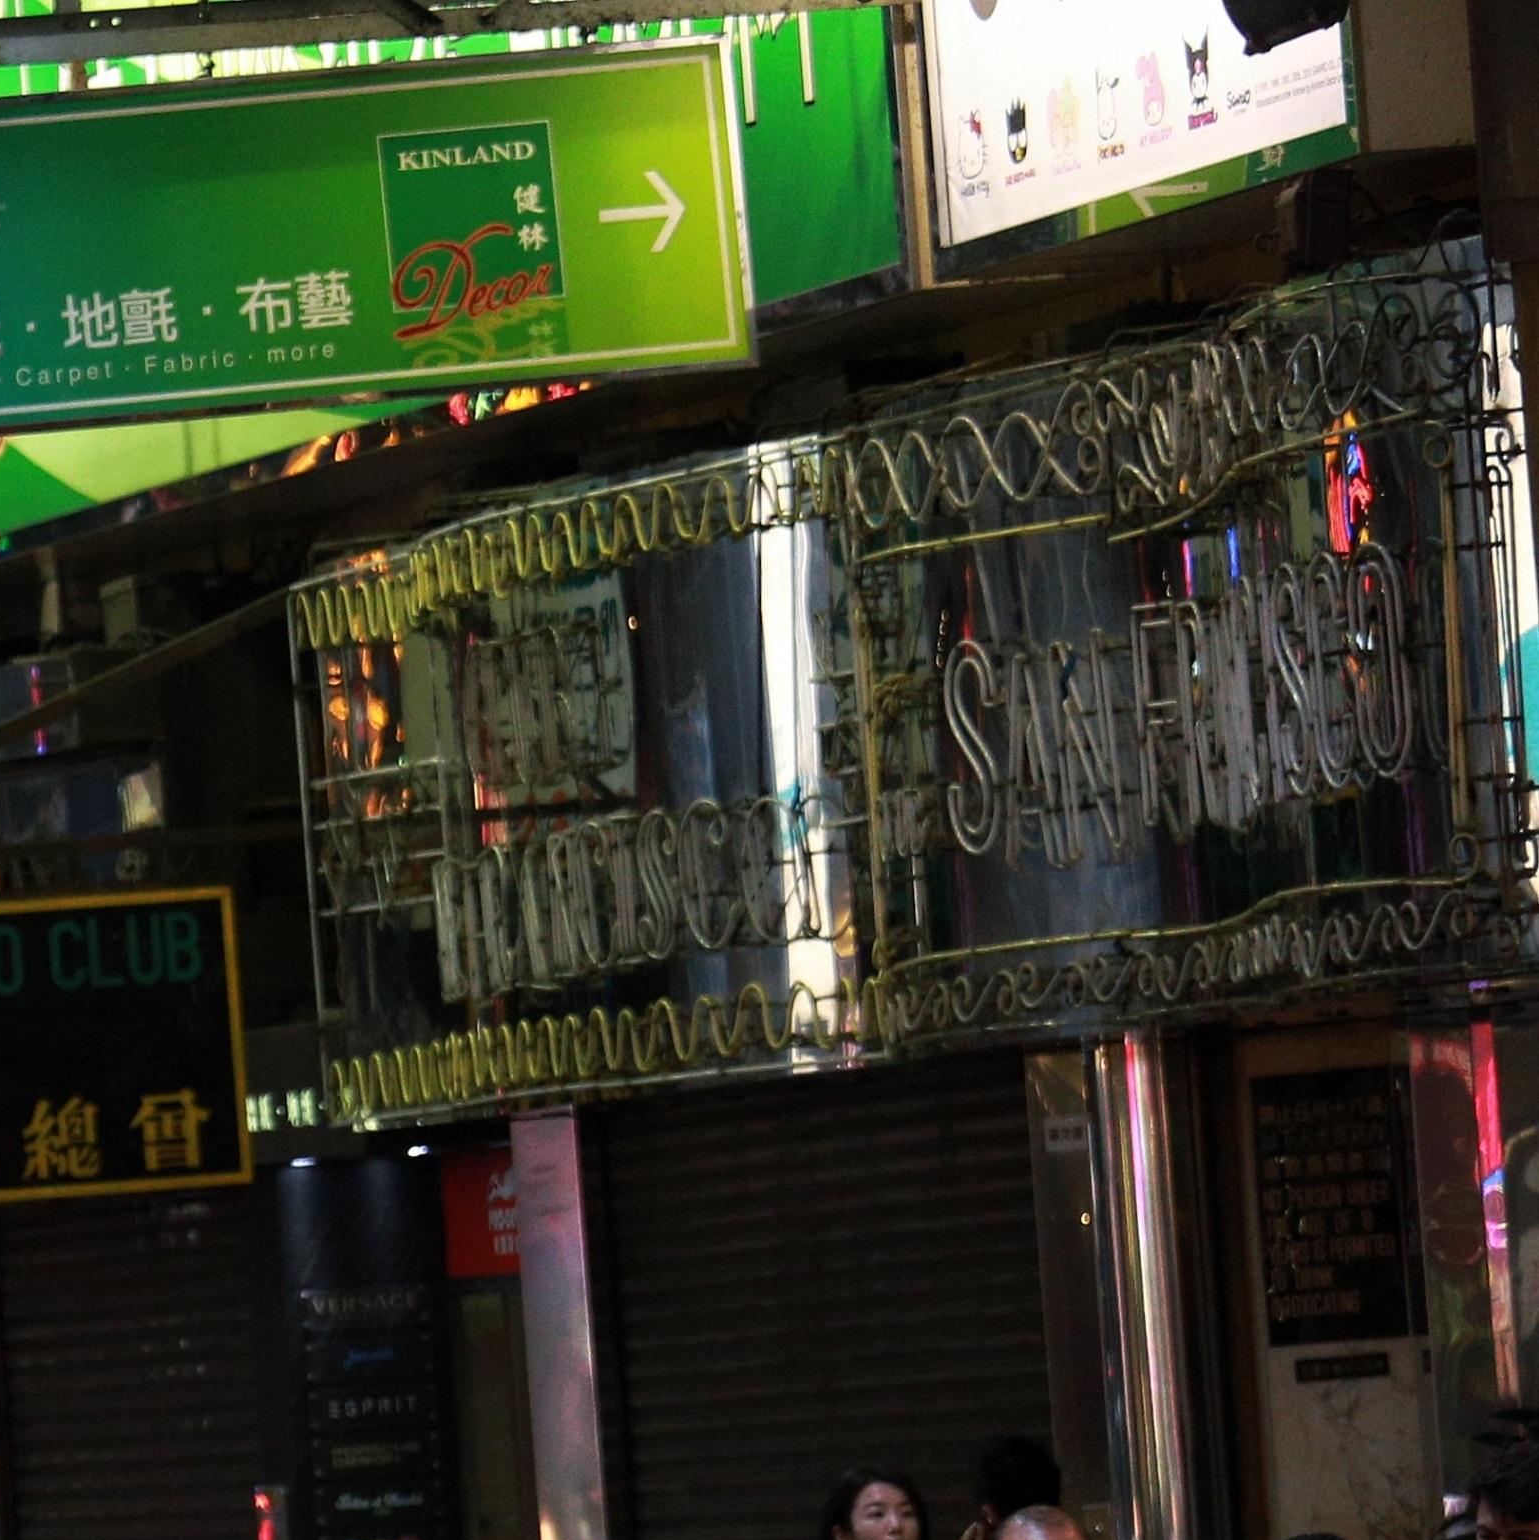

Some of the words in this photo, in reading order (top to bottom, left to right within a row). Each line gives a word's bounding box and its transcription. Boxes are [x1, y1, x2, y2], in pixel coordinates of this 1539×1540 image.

[398, 141, 536, 171] KINLAND
[513, 183, 549, 251] 健林
[60, 288, 178, 349] 地氈
[236, 271, 353, 334] 布藝
[393, 223, 554, 341] Decor
[15, 361, 113, 388] Carpet
[144, 349, 236, 373] Fabric
[267, 342, 336, 362] more
[48, 911, 206, 991] CLUB
